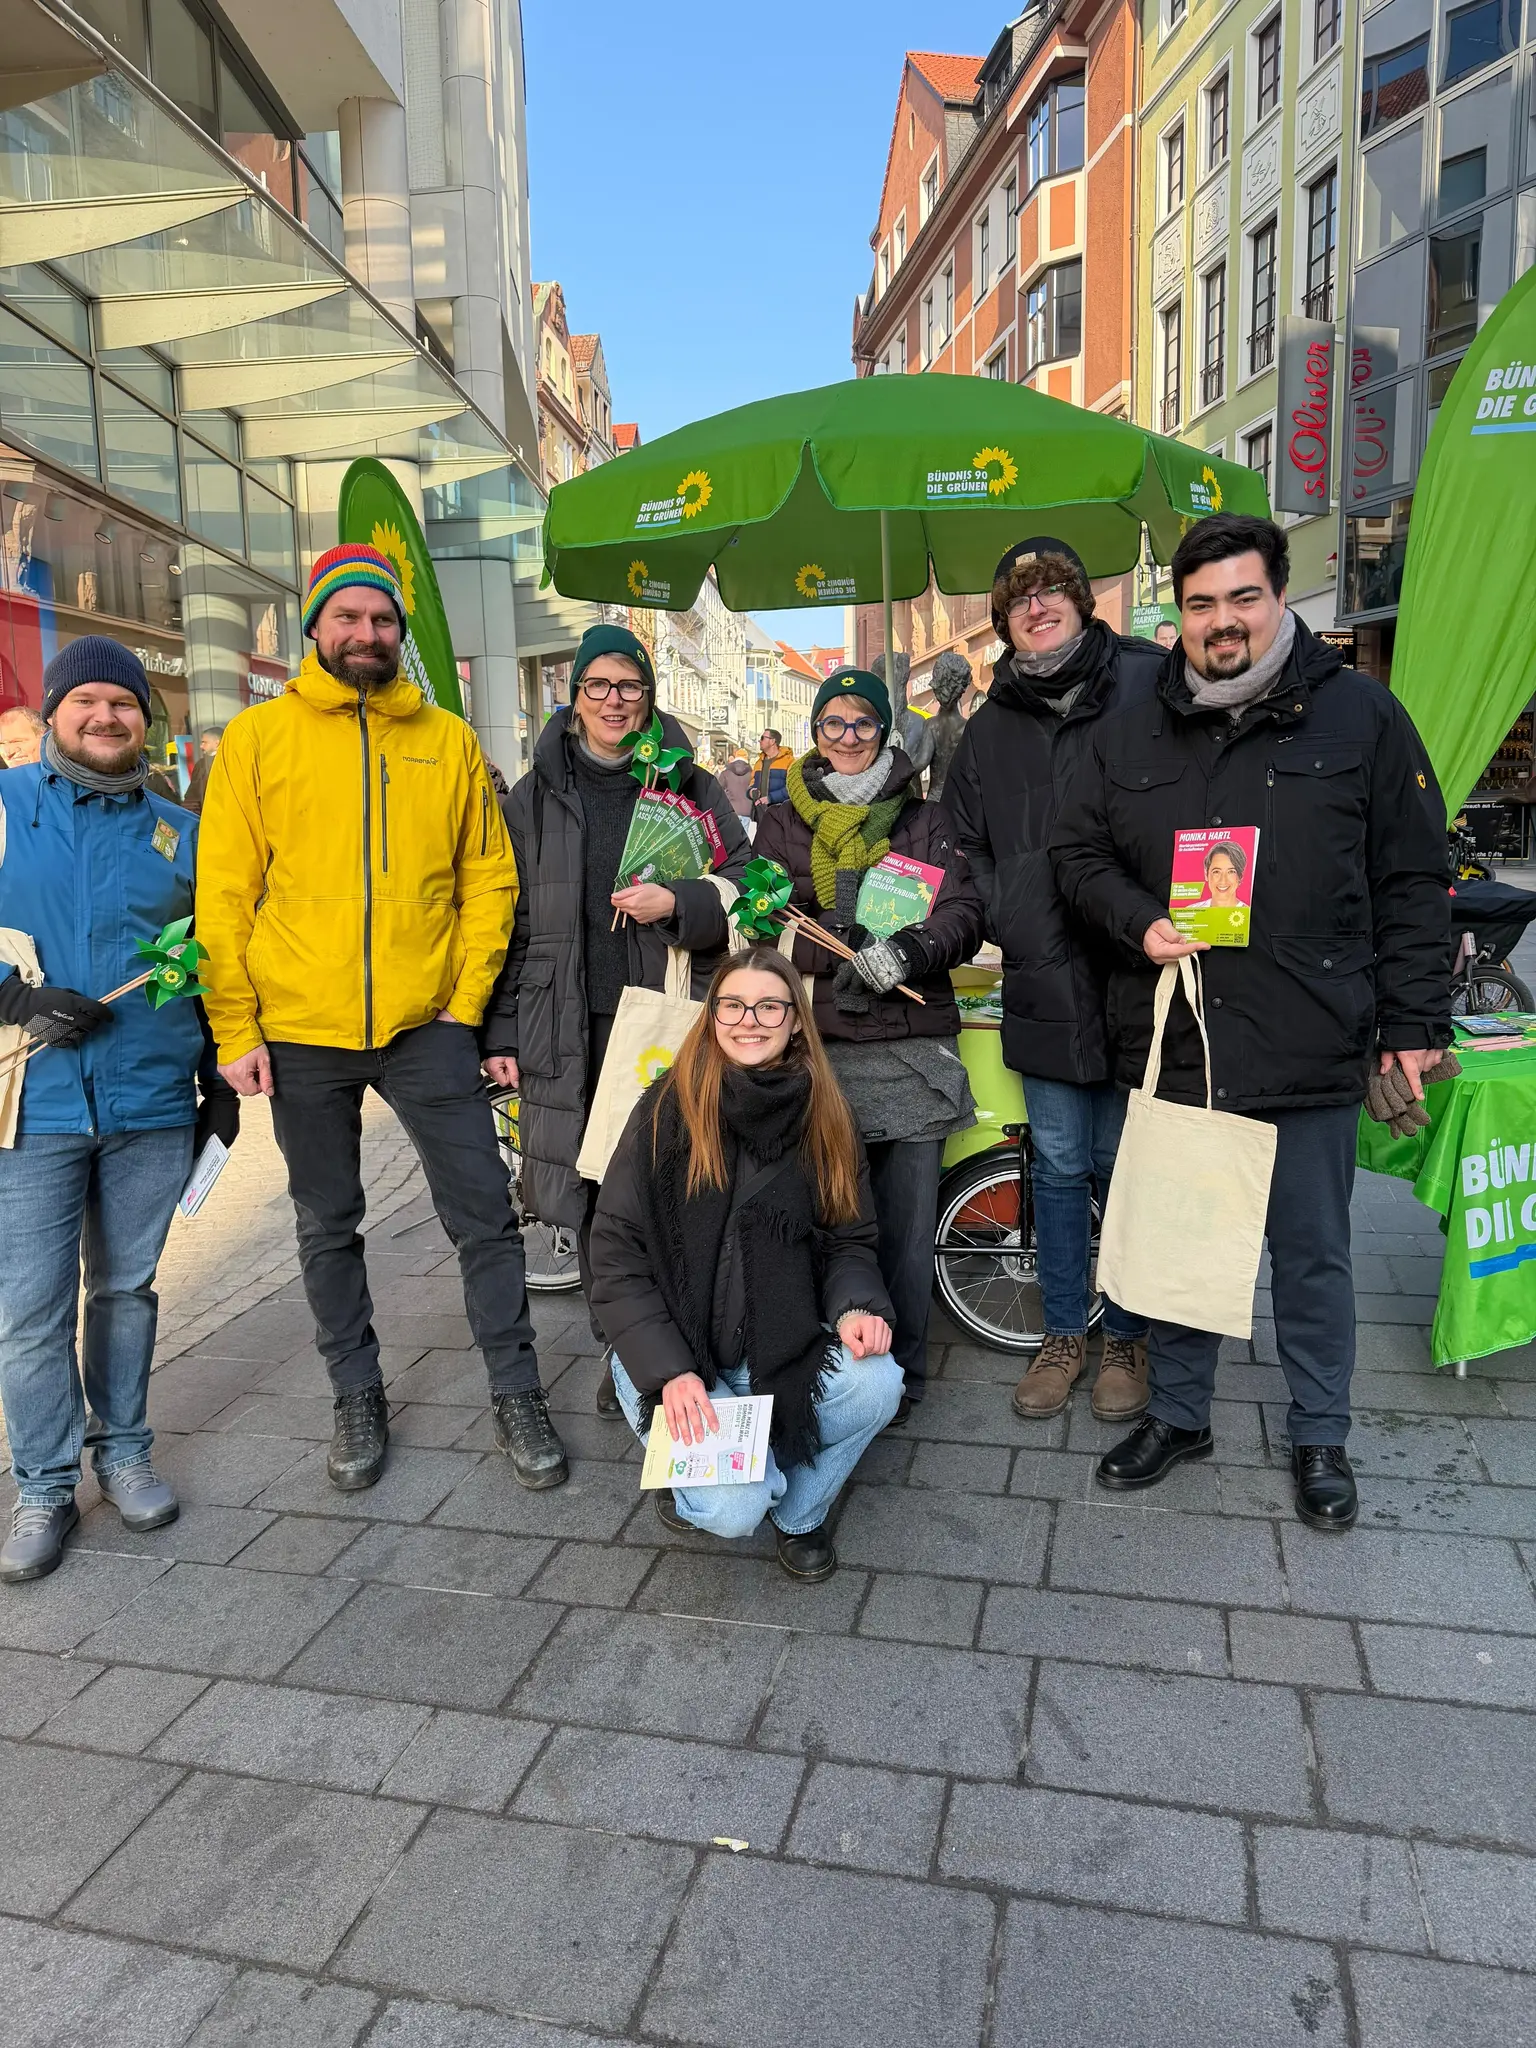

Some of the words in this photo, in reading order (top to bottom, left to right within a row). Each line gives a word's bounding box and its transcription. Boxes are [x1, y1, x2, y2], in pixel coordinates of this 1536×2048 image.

[1485, 361, 1536, 391] BÜN
[1476, 395, 1517, 419] DIE
[1289, 340, 1330, 498] s.Oliver
[927, 470, 972, 482] BÜNDNIS
[975, 471, 988, 480] 90
[927, 484, 943, 493] DIE
[947, 480, 988, 492] GRÜNEN
[640, 498, 675, 512] BÜNDNIS
[676, 496, 686, 506] 90
[637, 513, 651, 522] DIE
[653, 507, 684, 521] GRÜNEN
[1132, 606, 1162, 617] MICHAEL
[1132, 614, 1165, 625] MARKERT
[1179, 832, 1207, 842] MONIKA
[1208, 830, 1231, 841] HARTL
[903, 862, 923, 875] HARTL
[869, 871, 882, 880] WIR
[882, 874, 896, 885] FÜR
[867, 879, 919, 901] ASCHAFFENBURG
[1462, 1137, 1536, 1197] BÜN
